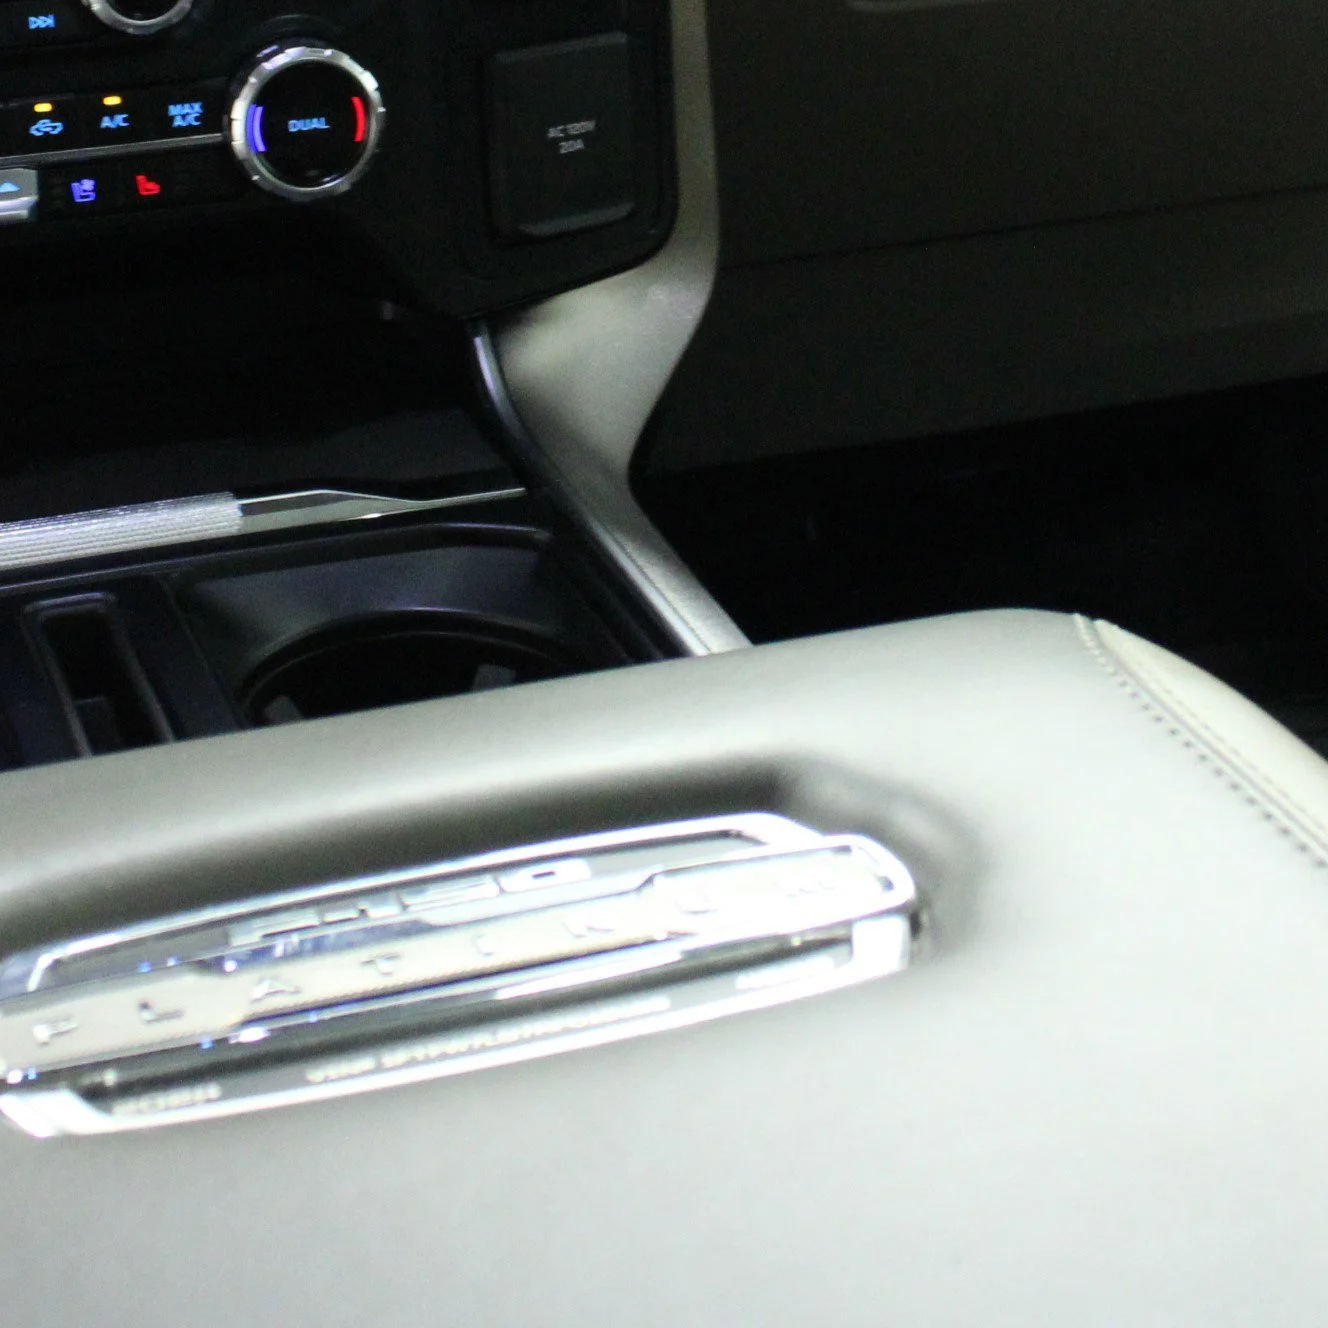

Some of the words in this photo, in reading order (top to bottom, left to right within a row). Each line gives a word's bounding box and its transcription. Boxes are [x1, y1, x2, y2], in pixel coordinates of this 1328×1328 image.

[168, 103, 202, 116] MAX
[100, 114, 129, 129] A/C
[173, 114, 201, 127] A/C
[288, 116, 330, 131] DUAL
